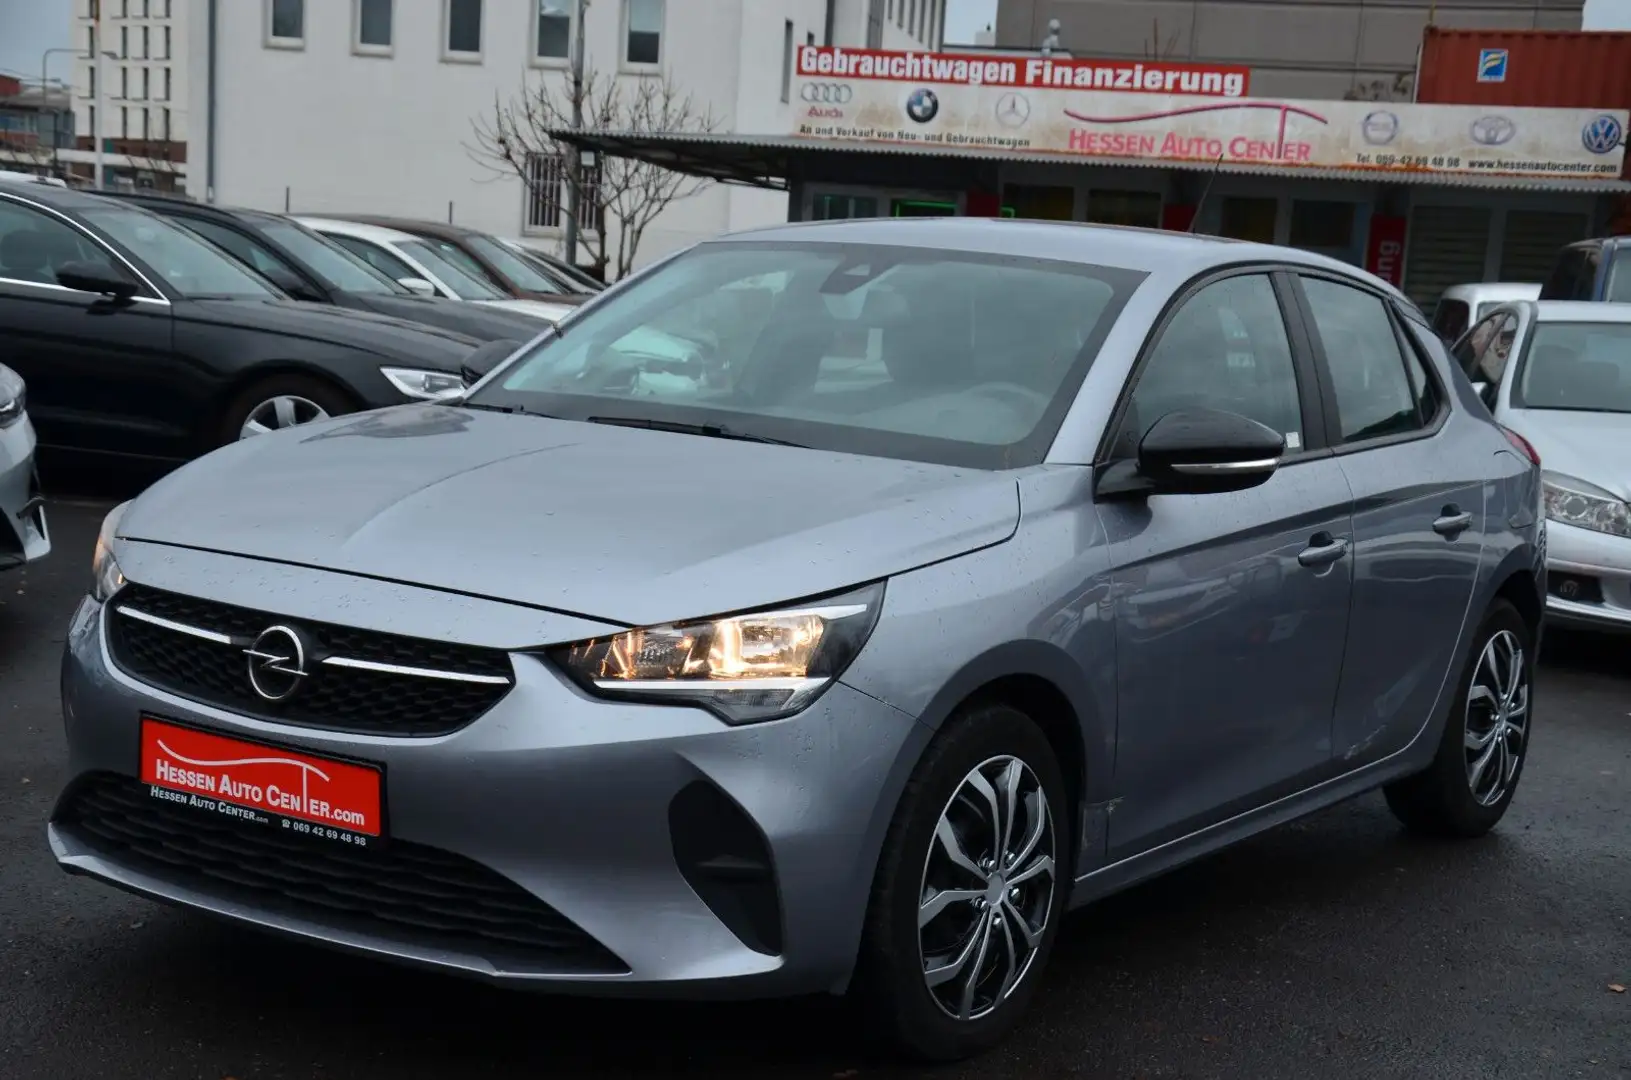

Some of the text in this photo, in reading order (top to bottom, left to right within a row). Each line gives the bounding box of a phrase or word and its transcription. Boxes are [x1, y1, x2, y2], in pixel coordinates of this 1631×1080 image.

[801, 46, 1244, 96] Gebrauchtwagen Finanzierung
[800, 124, 813, 134] An
[815, 126, 833, 135] und
[836, 127, 875, 138] Verkauf
[877, 131, 895, 139] von
[924, 133, 943, 142] und
[946, 133, 1031, 149] Gebrauchtwagen
[1068, 116, 1312, 161] HESSEN AUTO CENTER
[1468, 159, 1618, 173] www.hessenautocenter.com
[156, 758, 365, 826] HESSEN AUTO CENTER.com
[150, 786, 188, 804] HESSEN
[189, 795, 216, 811] AUTO
[293, 821, 310, 834] 069
[312, 826, 325, 837] 42
[326, 829, 338, 840] 69
[340, 833, 352, 843] 48
[354, 836, 367, 847] 98
